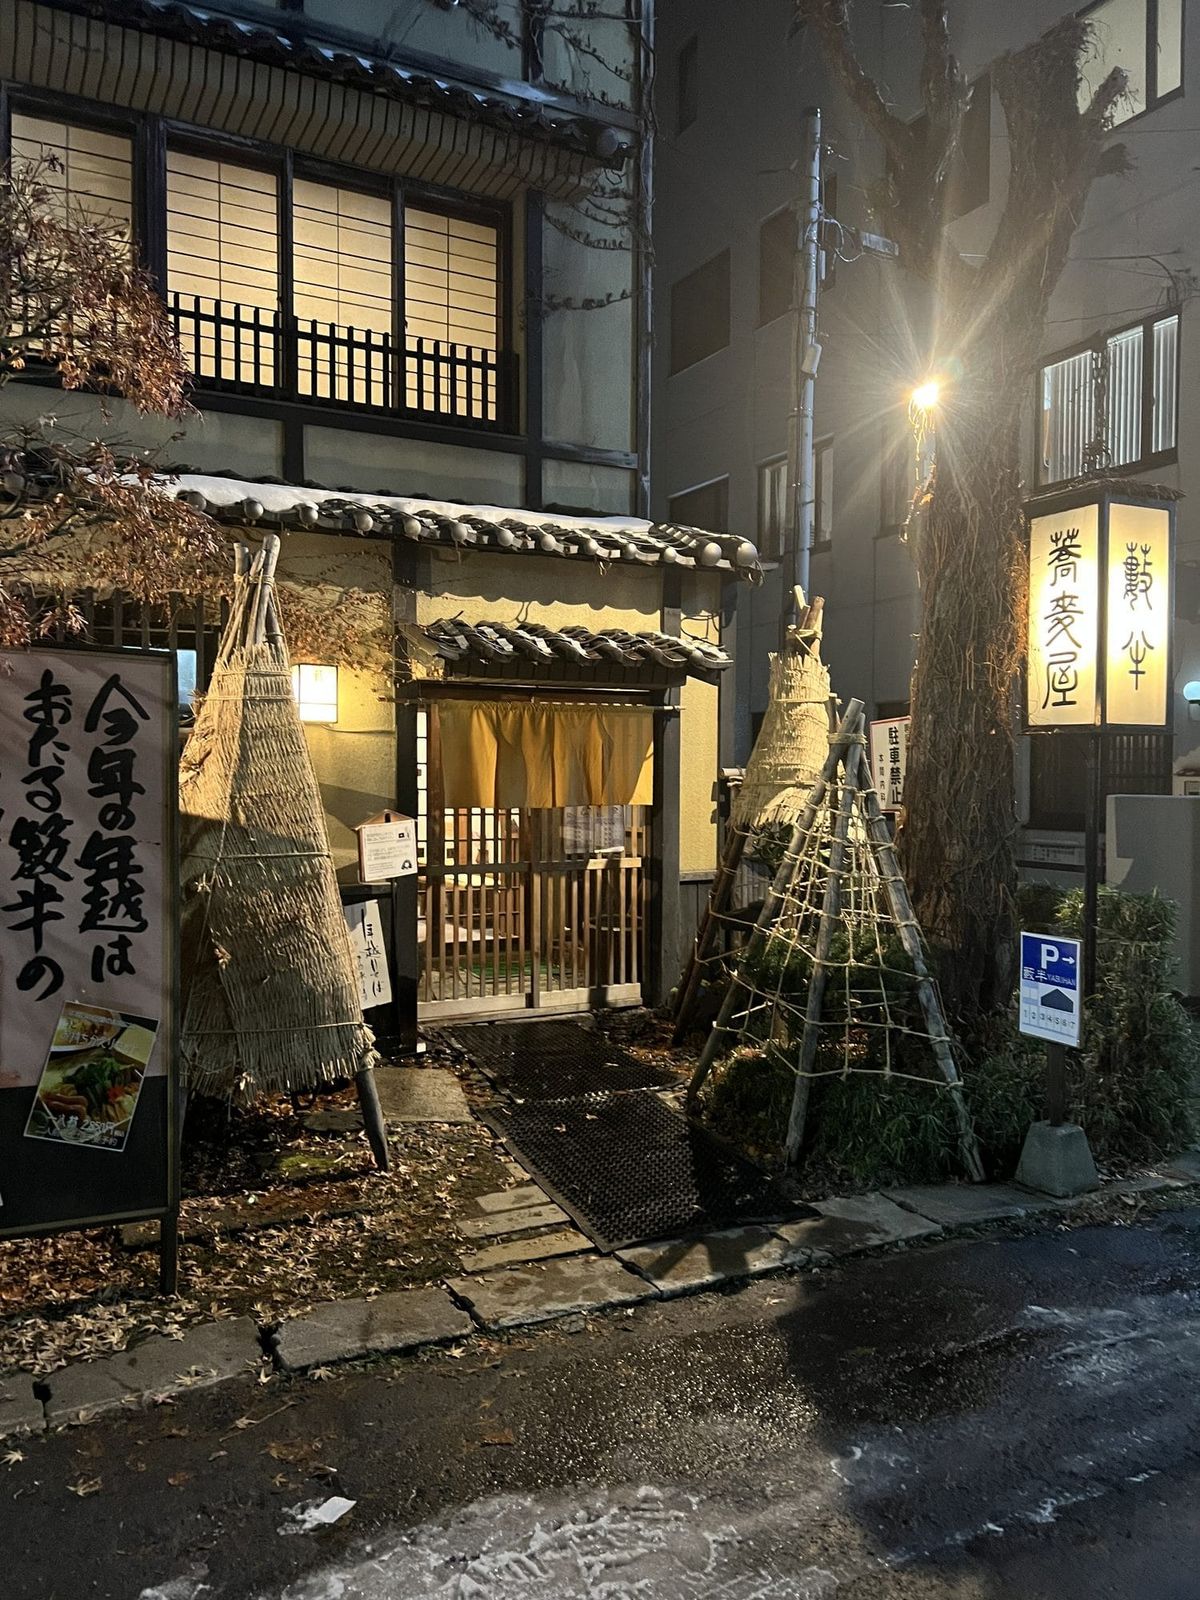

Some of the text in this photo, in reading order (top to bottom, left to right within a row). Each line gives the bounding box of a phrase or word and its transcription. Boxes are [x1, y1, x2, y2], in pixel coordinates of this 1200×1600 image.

[888, 726, 903, 805] 駐車禁止
[1041, 943, 1060, 970] P
